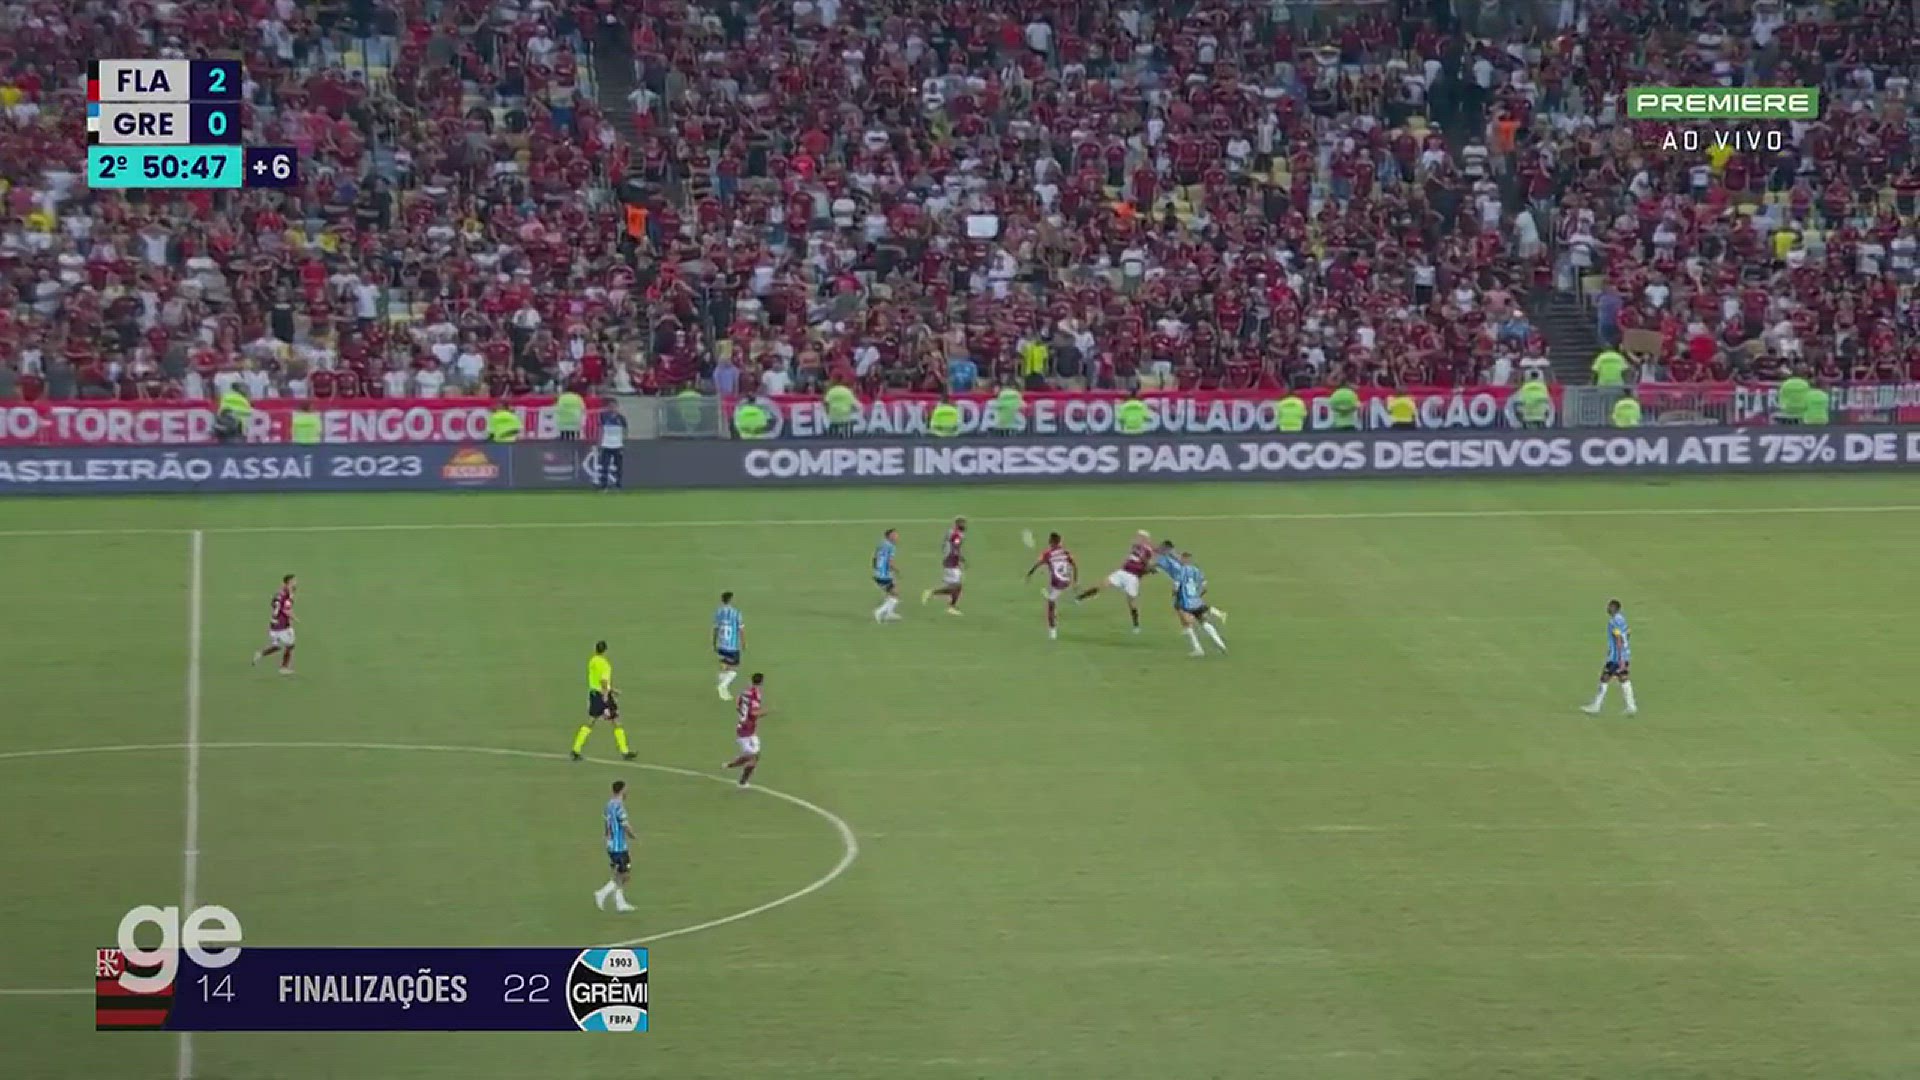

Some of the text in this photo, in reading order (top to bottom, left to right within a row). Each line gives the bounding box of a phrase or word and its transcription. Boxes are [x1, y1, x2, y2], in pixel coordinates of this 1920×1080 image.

[330, 455, 422, 477] 2023
[744, 446, 906, 477] COMPRE
[913, 445, 1120, 475] INGRESSOS
[1128, 443, 1232, 472] PARA
[1237, 440, 1367, 470] JOGOS
[1374, 438, 1572, 468] DECISIVOS
[1579, 436, 1668, 465] COM
[1677, 427, 1751, 463] ATÉ
[1758, 433, 1837, 463] 75%
[1844, 432, 1898, 462] DE
